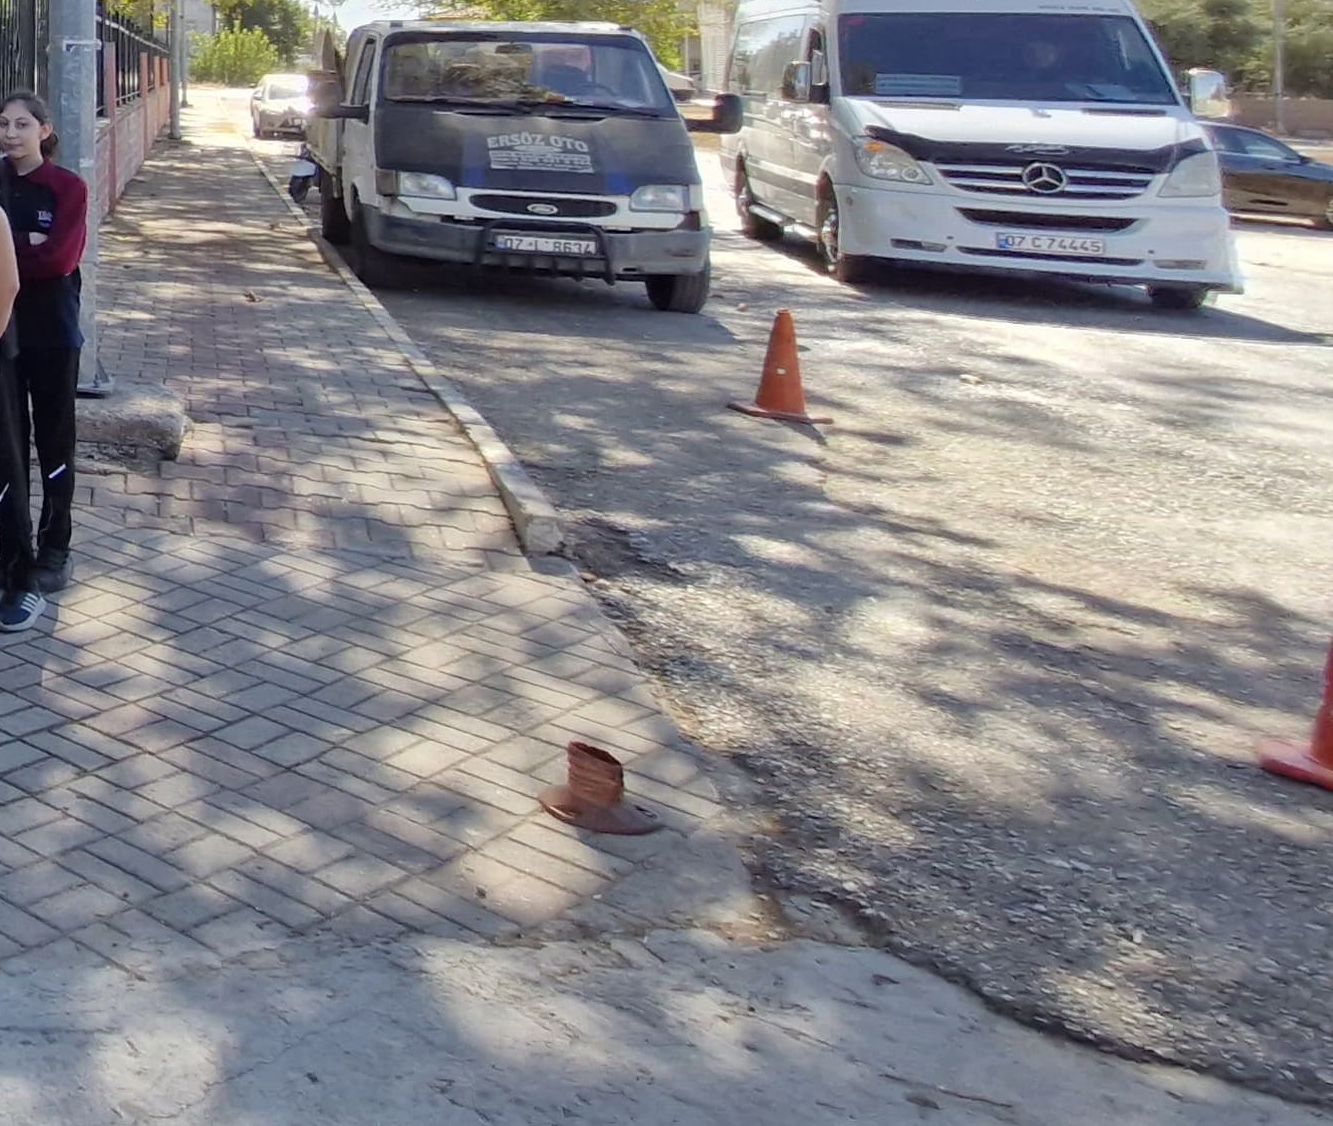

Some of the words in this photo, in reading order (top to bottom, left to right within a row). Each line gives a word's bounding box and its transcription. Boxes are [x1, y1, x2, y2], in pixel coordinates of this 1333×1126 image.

[487, 131, 545, 149] ERSÖZ
[549, 135, 589, 152] OTO
[504, 237, 524, 250] 07
[1006, 235, 1026, 247] 07
[1032, 236, 1042, 249] C
[1047, 238, 1101, 253] 74445
